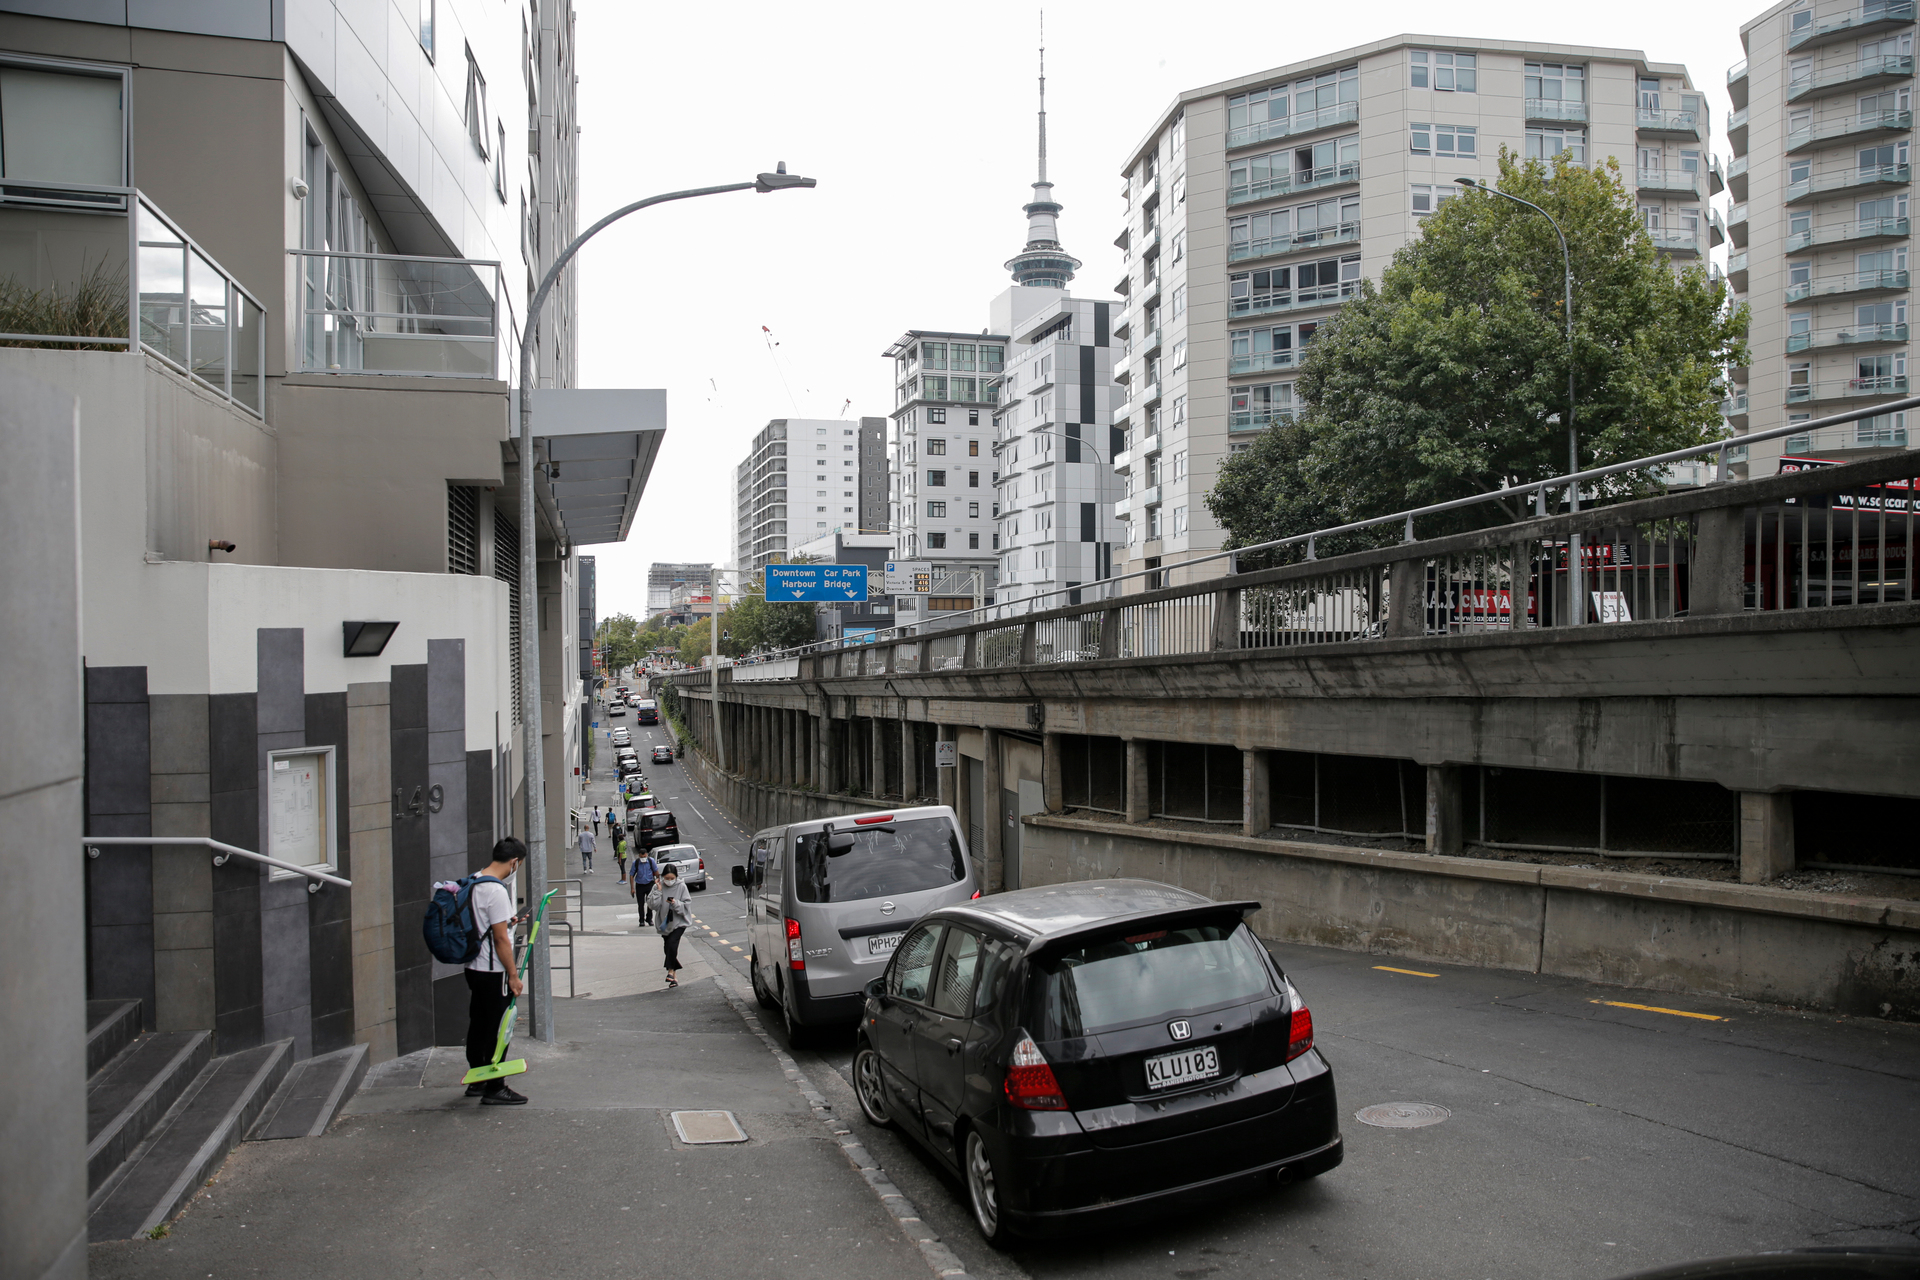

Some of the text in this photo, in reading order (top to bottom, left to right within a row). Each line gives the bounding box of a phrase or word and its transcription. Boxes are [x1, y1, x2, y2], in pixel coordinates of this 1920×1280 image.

[772, 569, 861, 577] Downtown Car Park
[782, 580, 852, 590] Harbour Bridge
[1492, 595, 1535, 609] VAT
[395, 783, 444, 819] 149
[1147, 1050, 1217, 1083] KLU103
